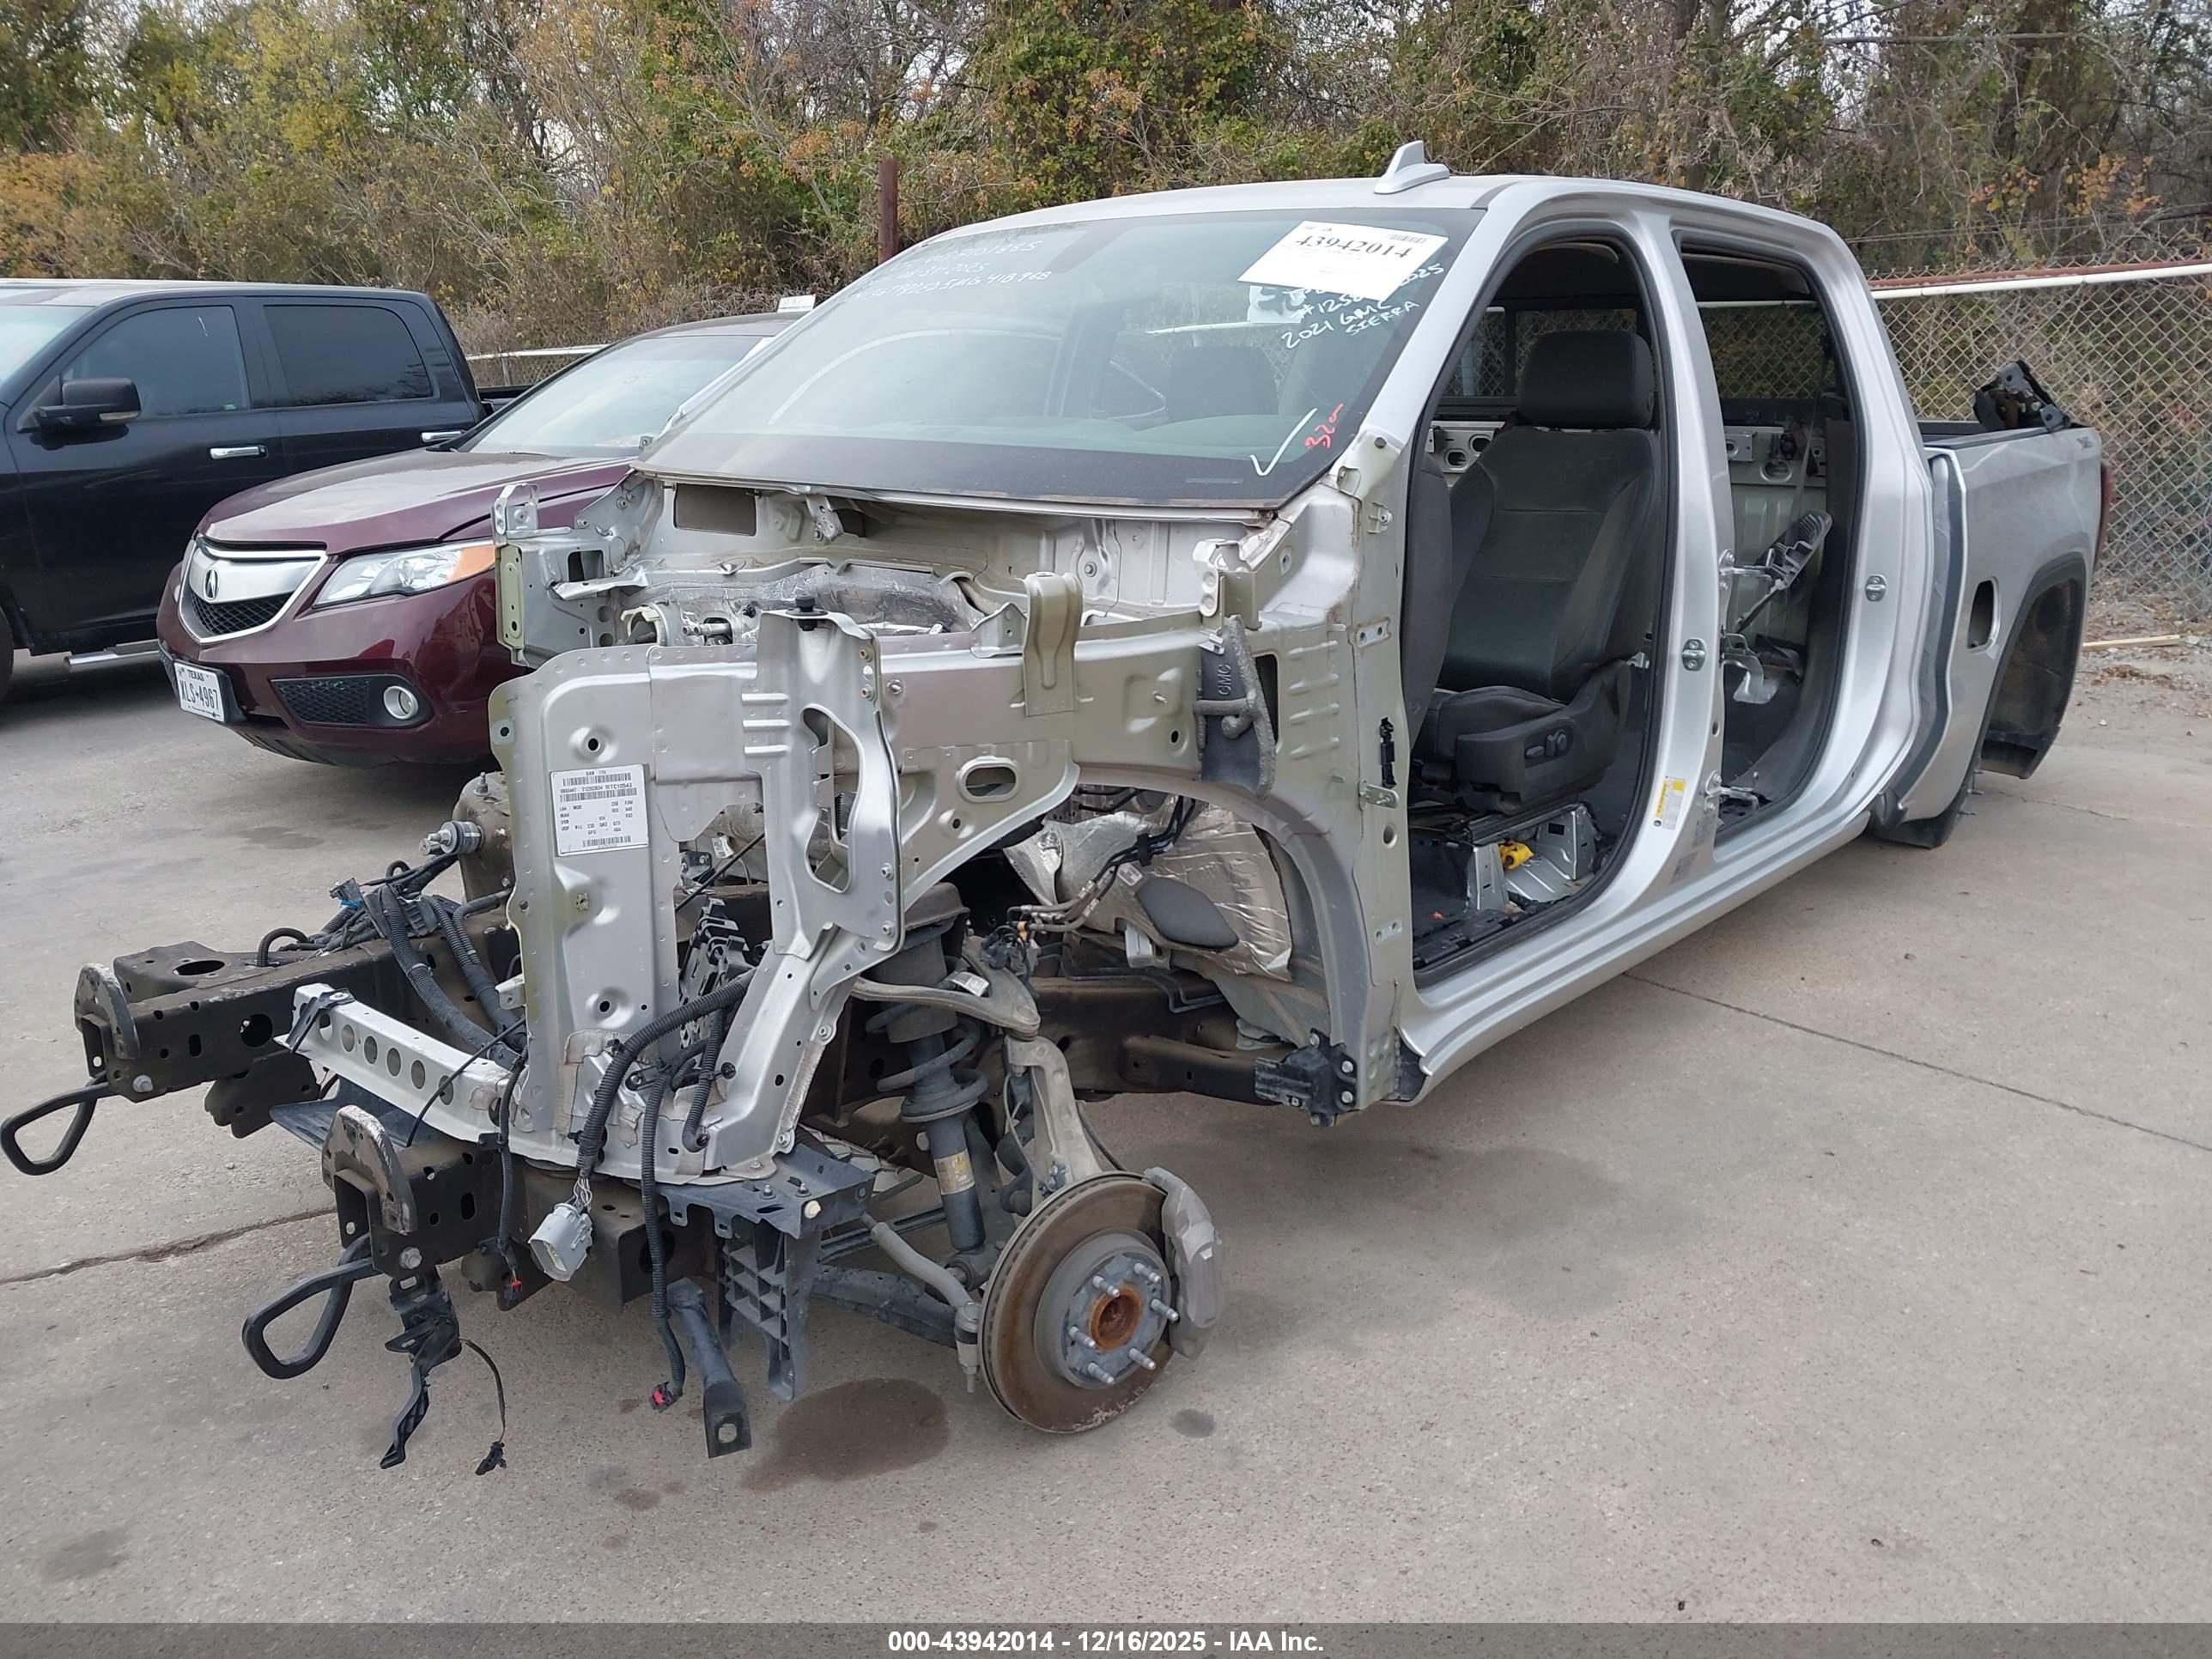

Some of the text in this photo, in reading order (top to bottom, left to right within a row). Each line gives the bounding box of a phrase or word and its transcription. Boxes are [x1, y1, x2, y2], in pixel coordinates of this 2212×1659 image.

[1296, 235, 1413, 258] 43942014
[1281, 301, 1393, 349] 2021 GMC
[1345, 301, 1420, 336] SIERRA
[186, 669, 204, 682] TEXAS
